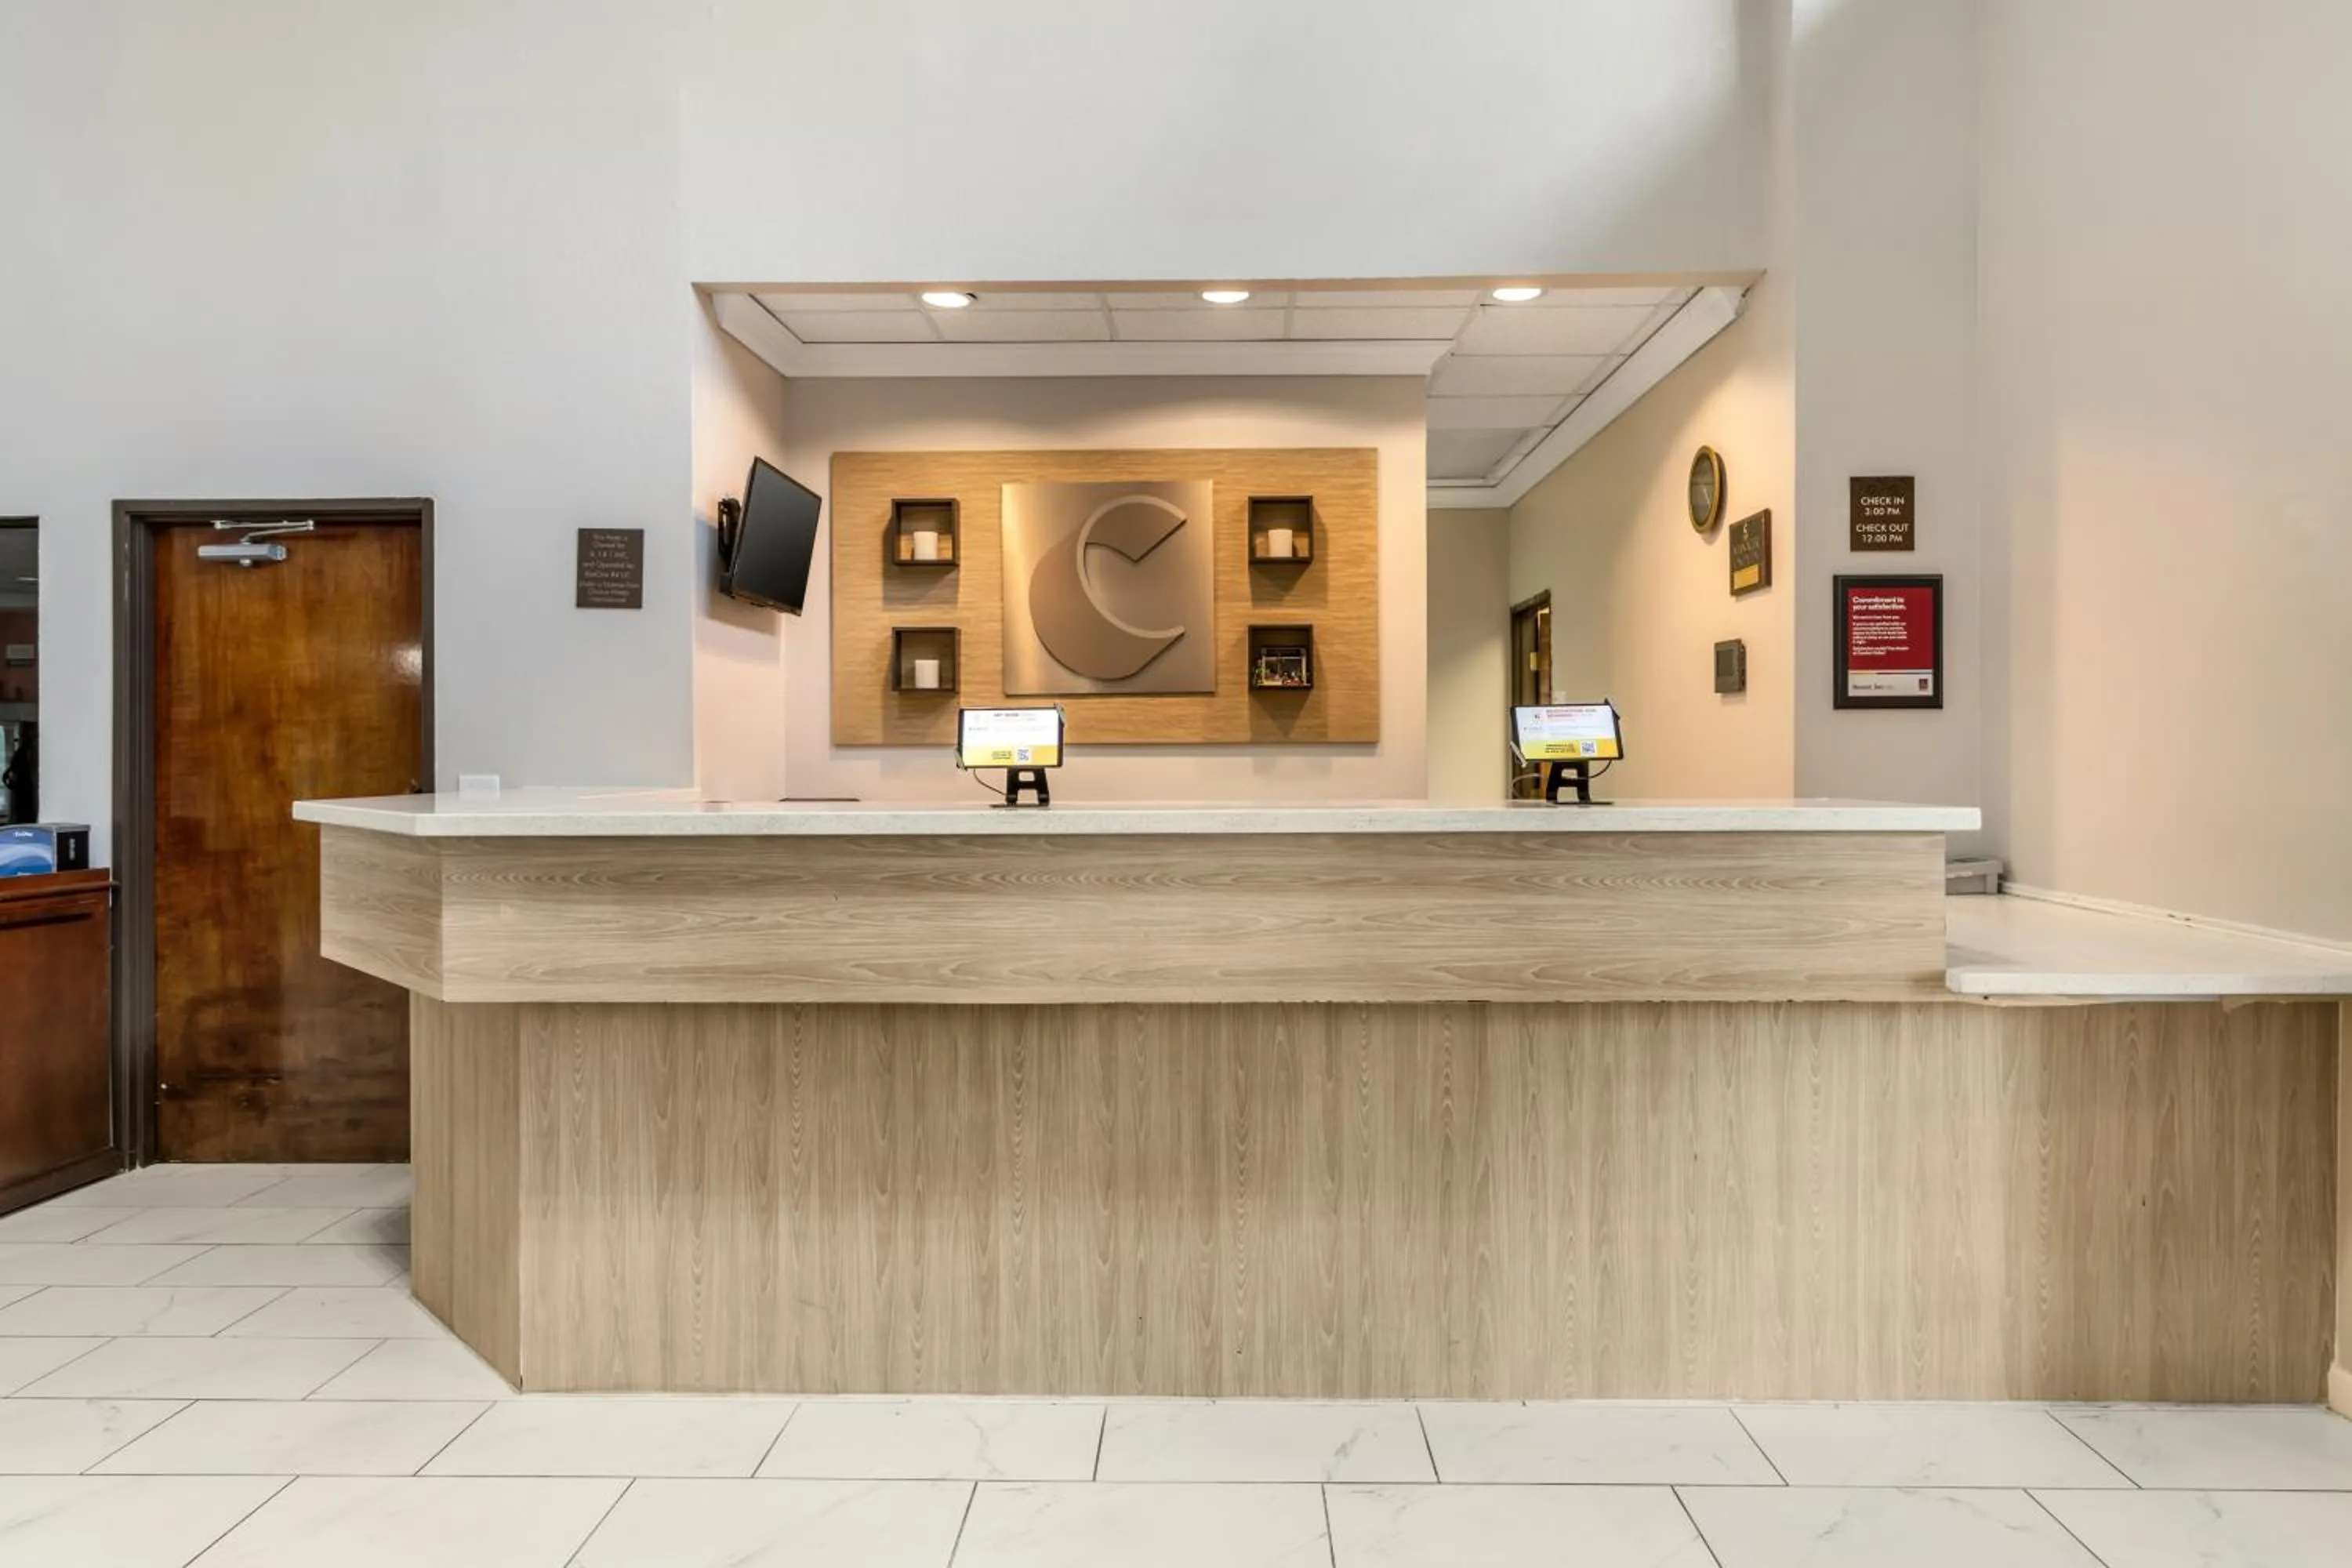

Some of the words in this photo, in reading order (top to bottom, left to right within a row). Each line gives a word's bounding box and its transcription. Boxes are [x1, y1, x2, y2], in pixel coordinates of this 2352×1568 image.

[1860, 496, 1891, 505] CHECK
[1893, 496, 1904, 505] IN
[1856, 523, 1886, 532] CHECK
[1889, 523, 1909, 532] OUT
[1862, 535, 1886, 543] 12:00
